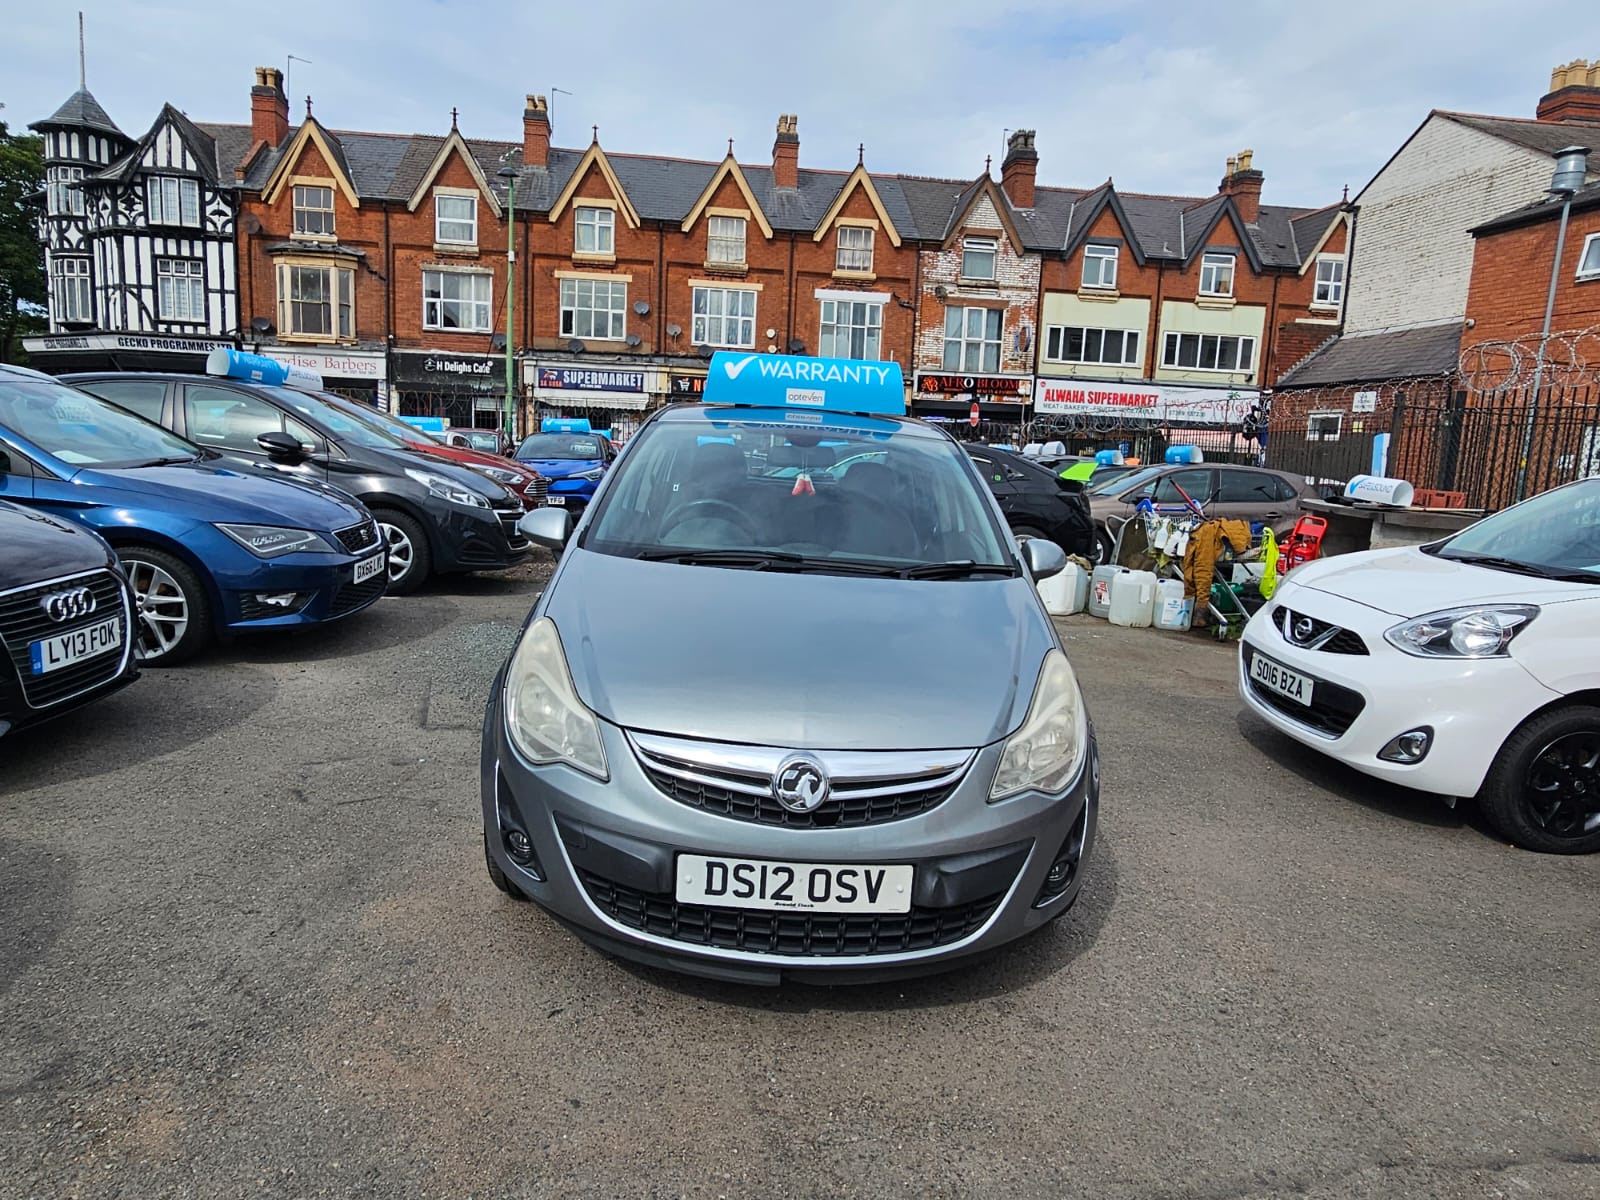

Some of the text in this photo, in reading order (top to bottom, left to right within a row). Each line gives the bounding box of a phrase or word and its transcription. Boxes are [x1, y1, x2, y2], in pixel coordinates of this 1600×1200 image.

[118, 337, 149, 348] GECKO
[151, 339, 215, 352] PROGRAMMES
[325, 356, 377, 370] Barbers
[758, 358, 890, 386] WARRANTY
[563, 371, 642, 387] SUPERMARKET
[941, 376, 1020, 390] AFRO BLOOM
[788, 392, 823, 402] opteven
[1044, 388, 1085, 404] ALWAHA
[1087, 391, 1159, 408] SUPERMARKET
[48, 621, 116, 664] LY13 FOK
[1256, 659, 1303, 699] SO16 BZA
[704, 861, 886, 904] DS12 OSV
